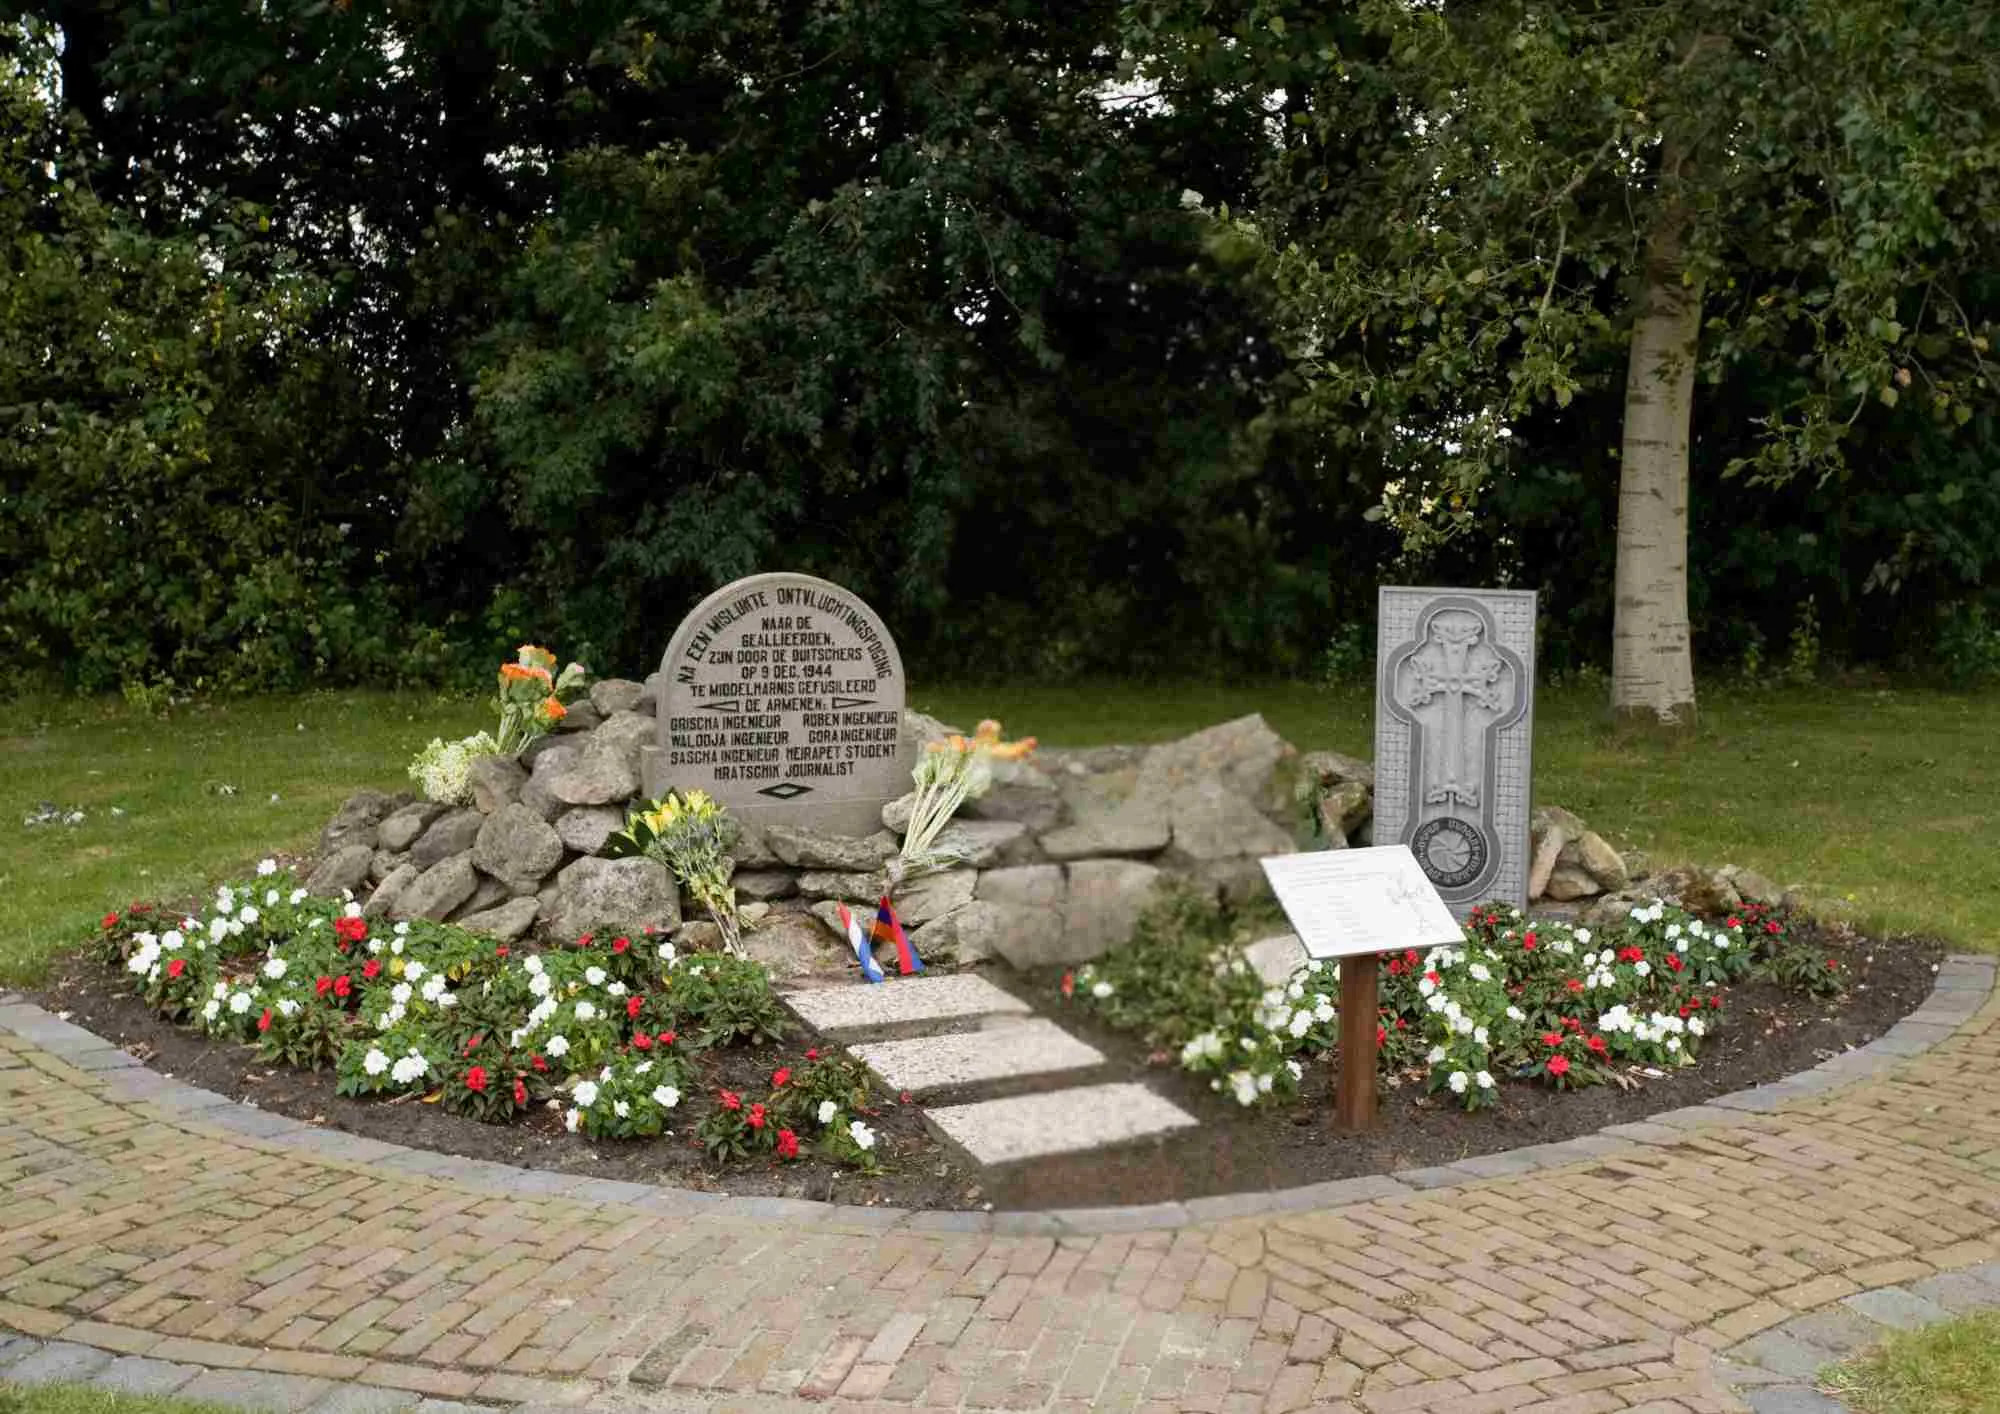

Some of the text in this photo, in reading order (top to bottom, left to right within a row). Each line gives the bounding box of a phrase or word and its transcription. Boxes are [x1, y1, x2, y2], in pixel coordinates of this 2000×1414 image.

[761, 616, 812, 631] NAAR DE
[686, 630, 713, 662] EEN
[737, 649, 768, 664] DOOR
[772, 649, 786, 663] DE
[792, 647, 863, 662] DUITSCHERS
[676, 665, 697, 684] NA
[741, 665, 757, 680] OP
[761, 665, 769, 679] 9
[801, 664, 832, 678] 1944
[690, 685, 706, 697] TE
[709, 681, 795, 697] MIDDELHARNIS
[745, 699, 761, 712] DE
[722, 714, 781, 730] INGENIEUR
[841, 711, 898, 726] INGENIEUR
[730, 731, 789, 746] INGENIEUR
[808, 728, 897, 744] GORA INGENIEUR
[670, 750, 718, 766] SASCHA
[720, 748, 780, 763] INGENIEUR
[845, 743, 897, 759] STUDENT
[784, 761, 855, 778] JOURNALIST
